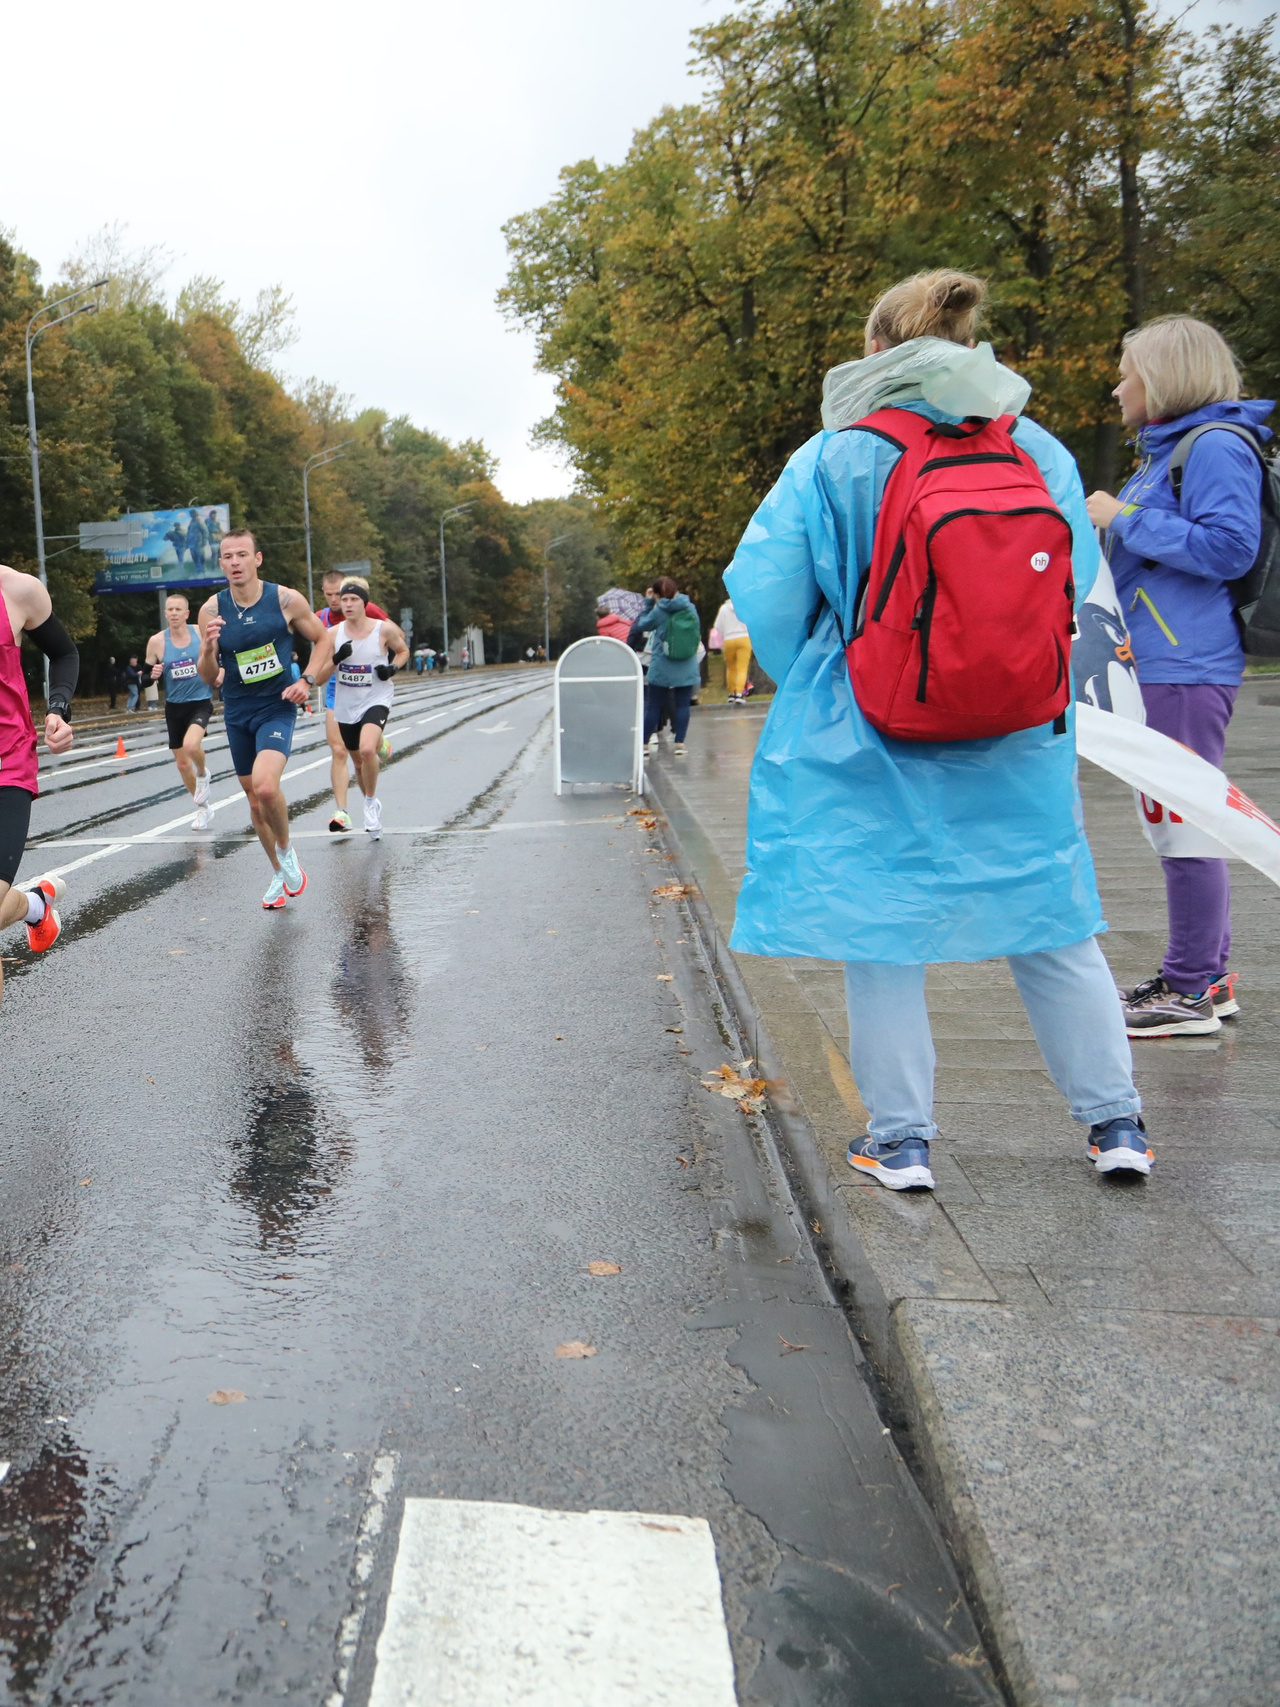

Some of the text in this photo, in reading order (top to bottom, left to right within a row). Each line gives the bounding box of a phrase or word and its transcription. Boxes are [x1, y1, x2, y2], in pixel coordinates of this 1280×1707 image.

[1035, 557, 1047, 566] hh
[174, 666, 194, 676] 6302
[245, 659, 276, 675] 4773
[341, 673, 365, 682] 6487
